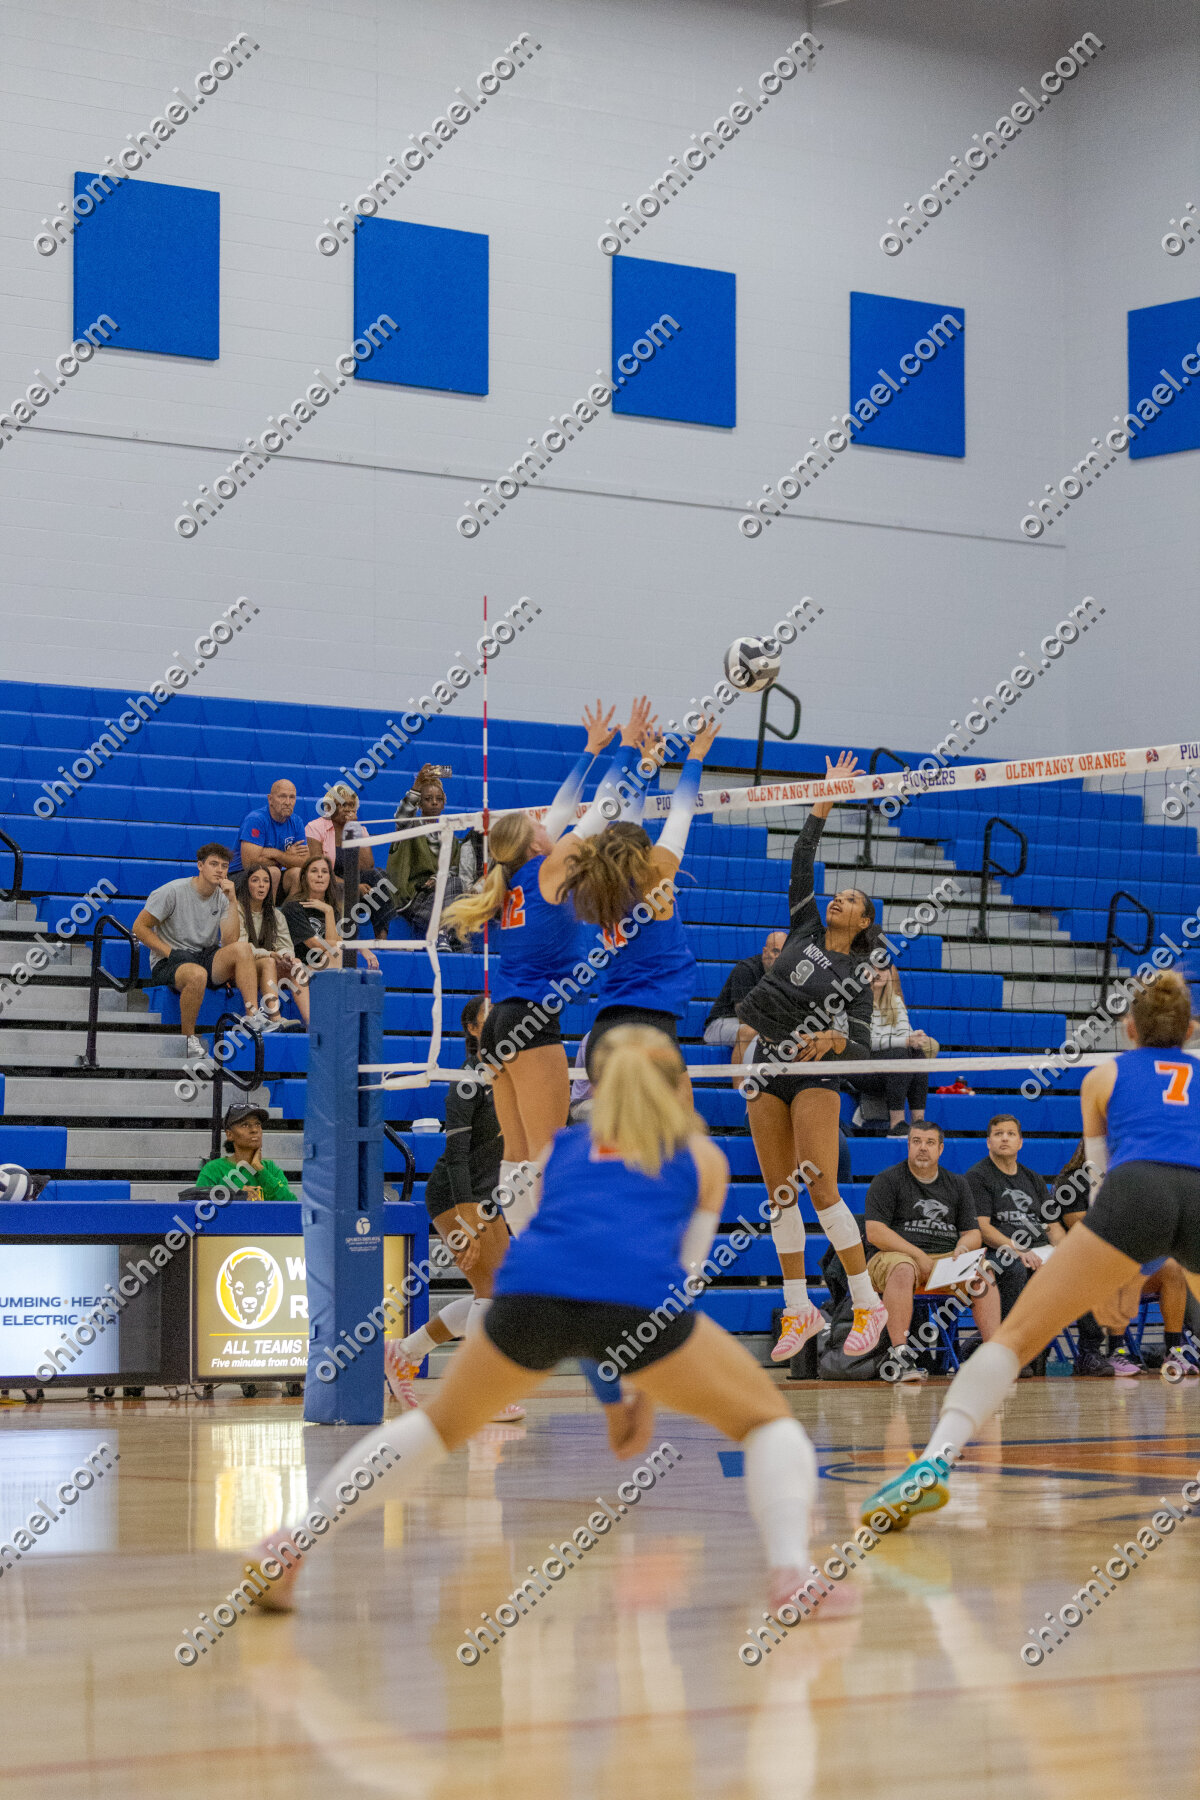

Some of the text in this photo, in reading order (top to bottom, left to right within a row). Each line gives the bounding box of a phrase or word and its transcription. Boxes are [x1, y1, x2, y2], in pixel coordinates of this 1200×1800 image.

[656, 793, 704, 811] PIOS
[747, 783, 809, 802] OLENTANGY
[812, 780, 856, 797] ORANGE
[1005, 757, 1074, 780] OLENTANGY
[1079, 752, 1127, 771] ORANGE
[1180, 743, 1200, 760] PIO
[803, 943, 832, 970] NORTH
[790, 959, 815, 986] 9
[1154, 1060, 1193, 1106] 7
[0, 1297, 61, 1308] UMBING
[3, 1315, 78, 1326] ELECTRIC
[222, 1340, 250, 1354] ALL
[254, 1339, 302, 1354] TEAMS
[211, 1358, 230, 1367] Five
[231, 1358, 266, 1367] minutes
[267, 1357, 288, 1367] from
